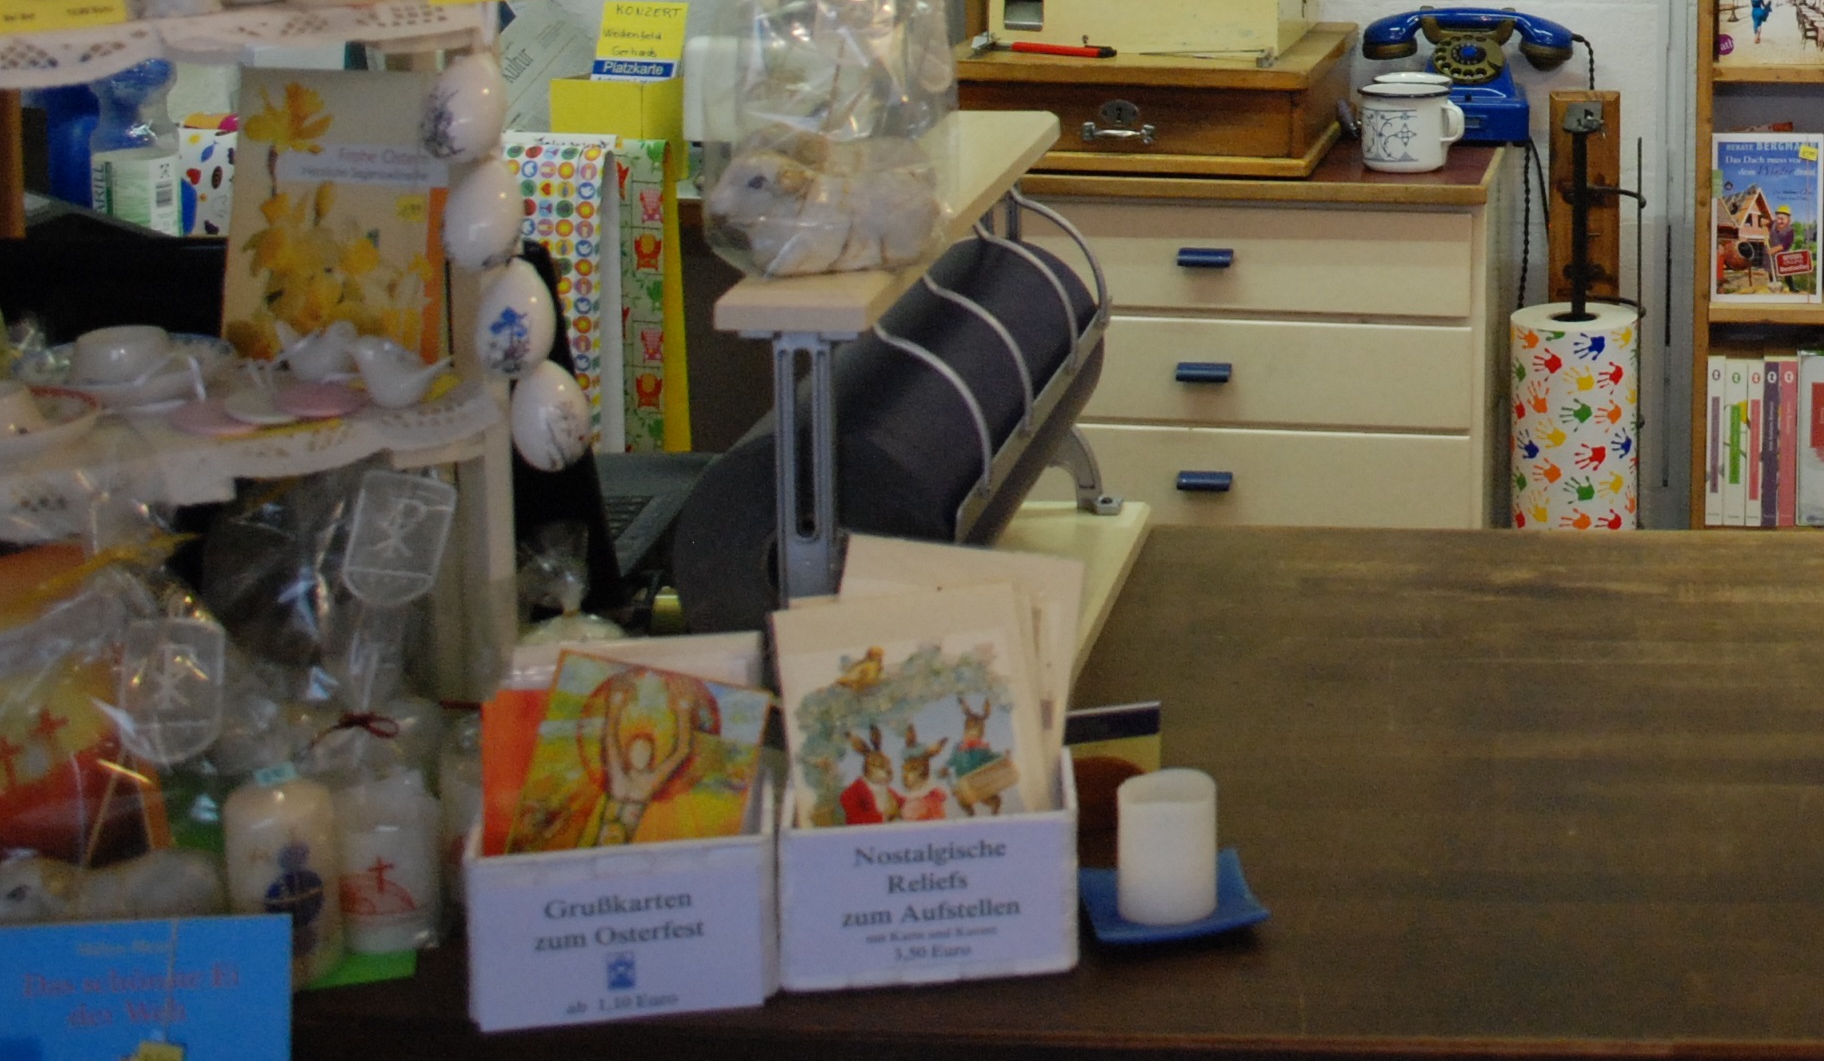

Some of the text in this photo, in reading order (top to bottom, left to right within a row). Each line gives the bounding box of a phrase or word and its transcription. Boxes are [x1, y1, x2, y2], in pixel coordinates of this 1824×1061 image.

[615, 4, 683, 19] KONZERT
[603, 61, 665, 76] Platzkarte
[853, 840, 1008, 869] Nostalgische
[887, 870, 969, 896] Reliefs
[544, 888, 692, 921] Grußkarten
[841, 897, 1022, 928] zum Aufstellen
[533, 919, 705, 952] zum Osterfest
[931, 943, 973, 960] Euro
